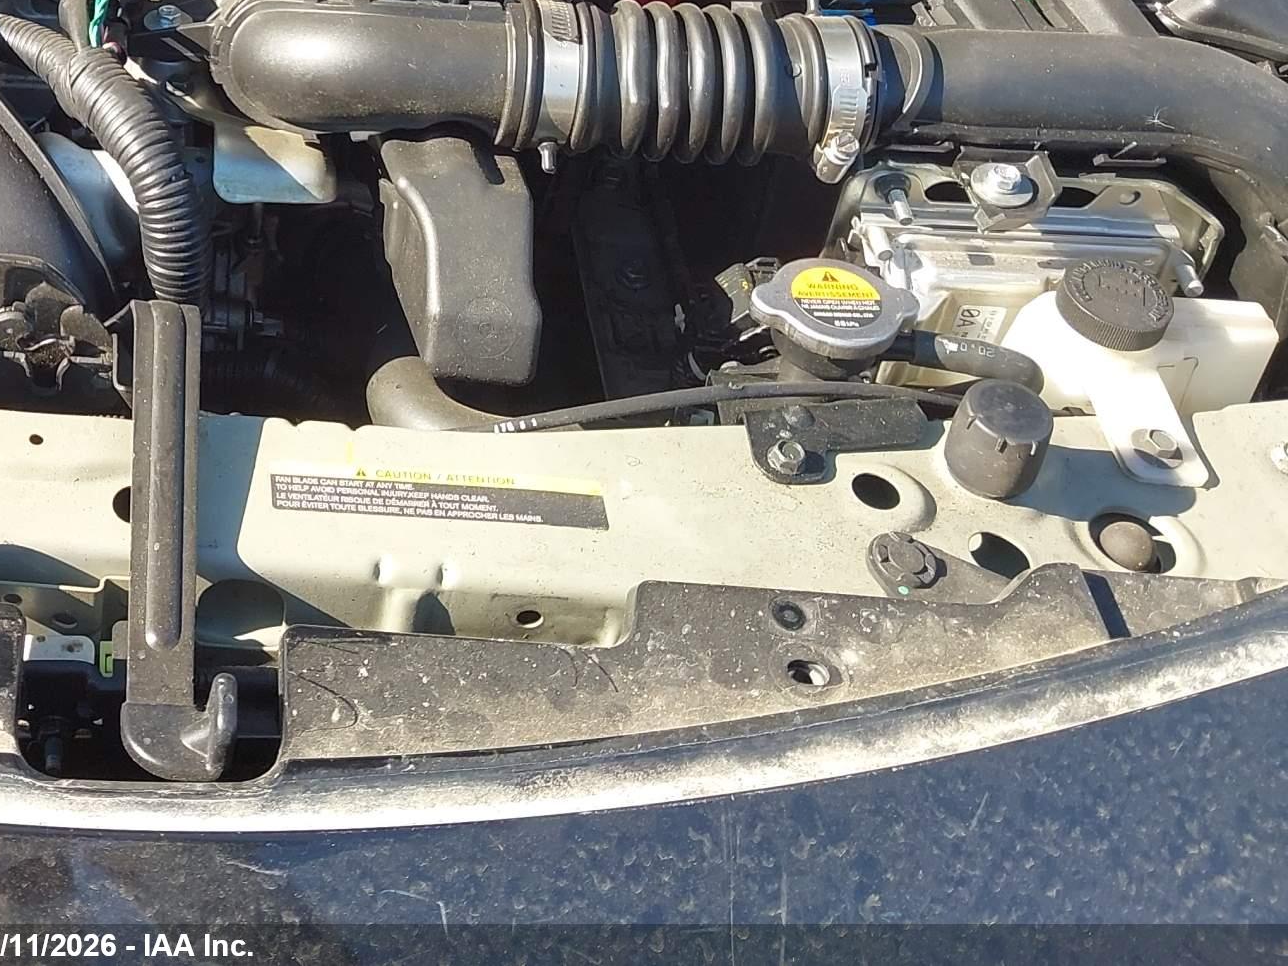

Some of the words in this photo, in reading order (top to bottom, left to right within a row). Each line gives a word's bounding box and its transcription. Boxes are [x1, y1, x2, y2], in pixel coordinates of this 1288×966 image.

[275, 476, 292, 484] FAN
[292, 476, 318, 485] BLADE
[320, 478, 338, 486] CAN
[338, 480, 364, 488] START
[364, 480, 375, 488] AT
[375, 469, 432, 481] CAUTION
[446, 474, 516, 484] ATTENTION
[276, 492, 286, 500] LE
[385, 497, 430, 508] DÉMARRER
[430, 499, 438, 508] À
[438, 502, 460, 510] TOUT
[461, 503, 498, 512] MOMENT.
[288, 484, 310, 492] HELP
[311, 486, 336, 494] AVOID
[336, 487, 380, 496] PERSONAL
[431, 492, 460, 501] HANDS
[460, 494, 490, 502] CLEAR.
[276, 500, 300, 508] POUR
[302, 500, 329, 510] ÉVITER
[330, 502, 357, 512] TOUTE
[358, 504, 402, 514] BLESSURE,
[404, 508, 415, 516] NE
[416, 508, 432, 516] PAS
[446, 510, 498, 520] APPROCHER
[516, 514, 544, 522] MAINS.
